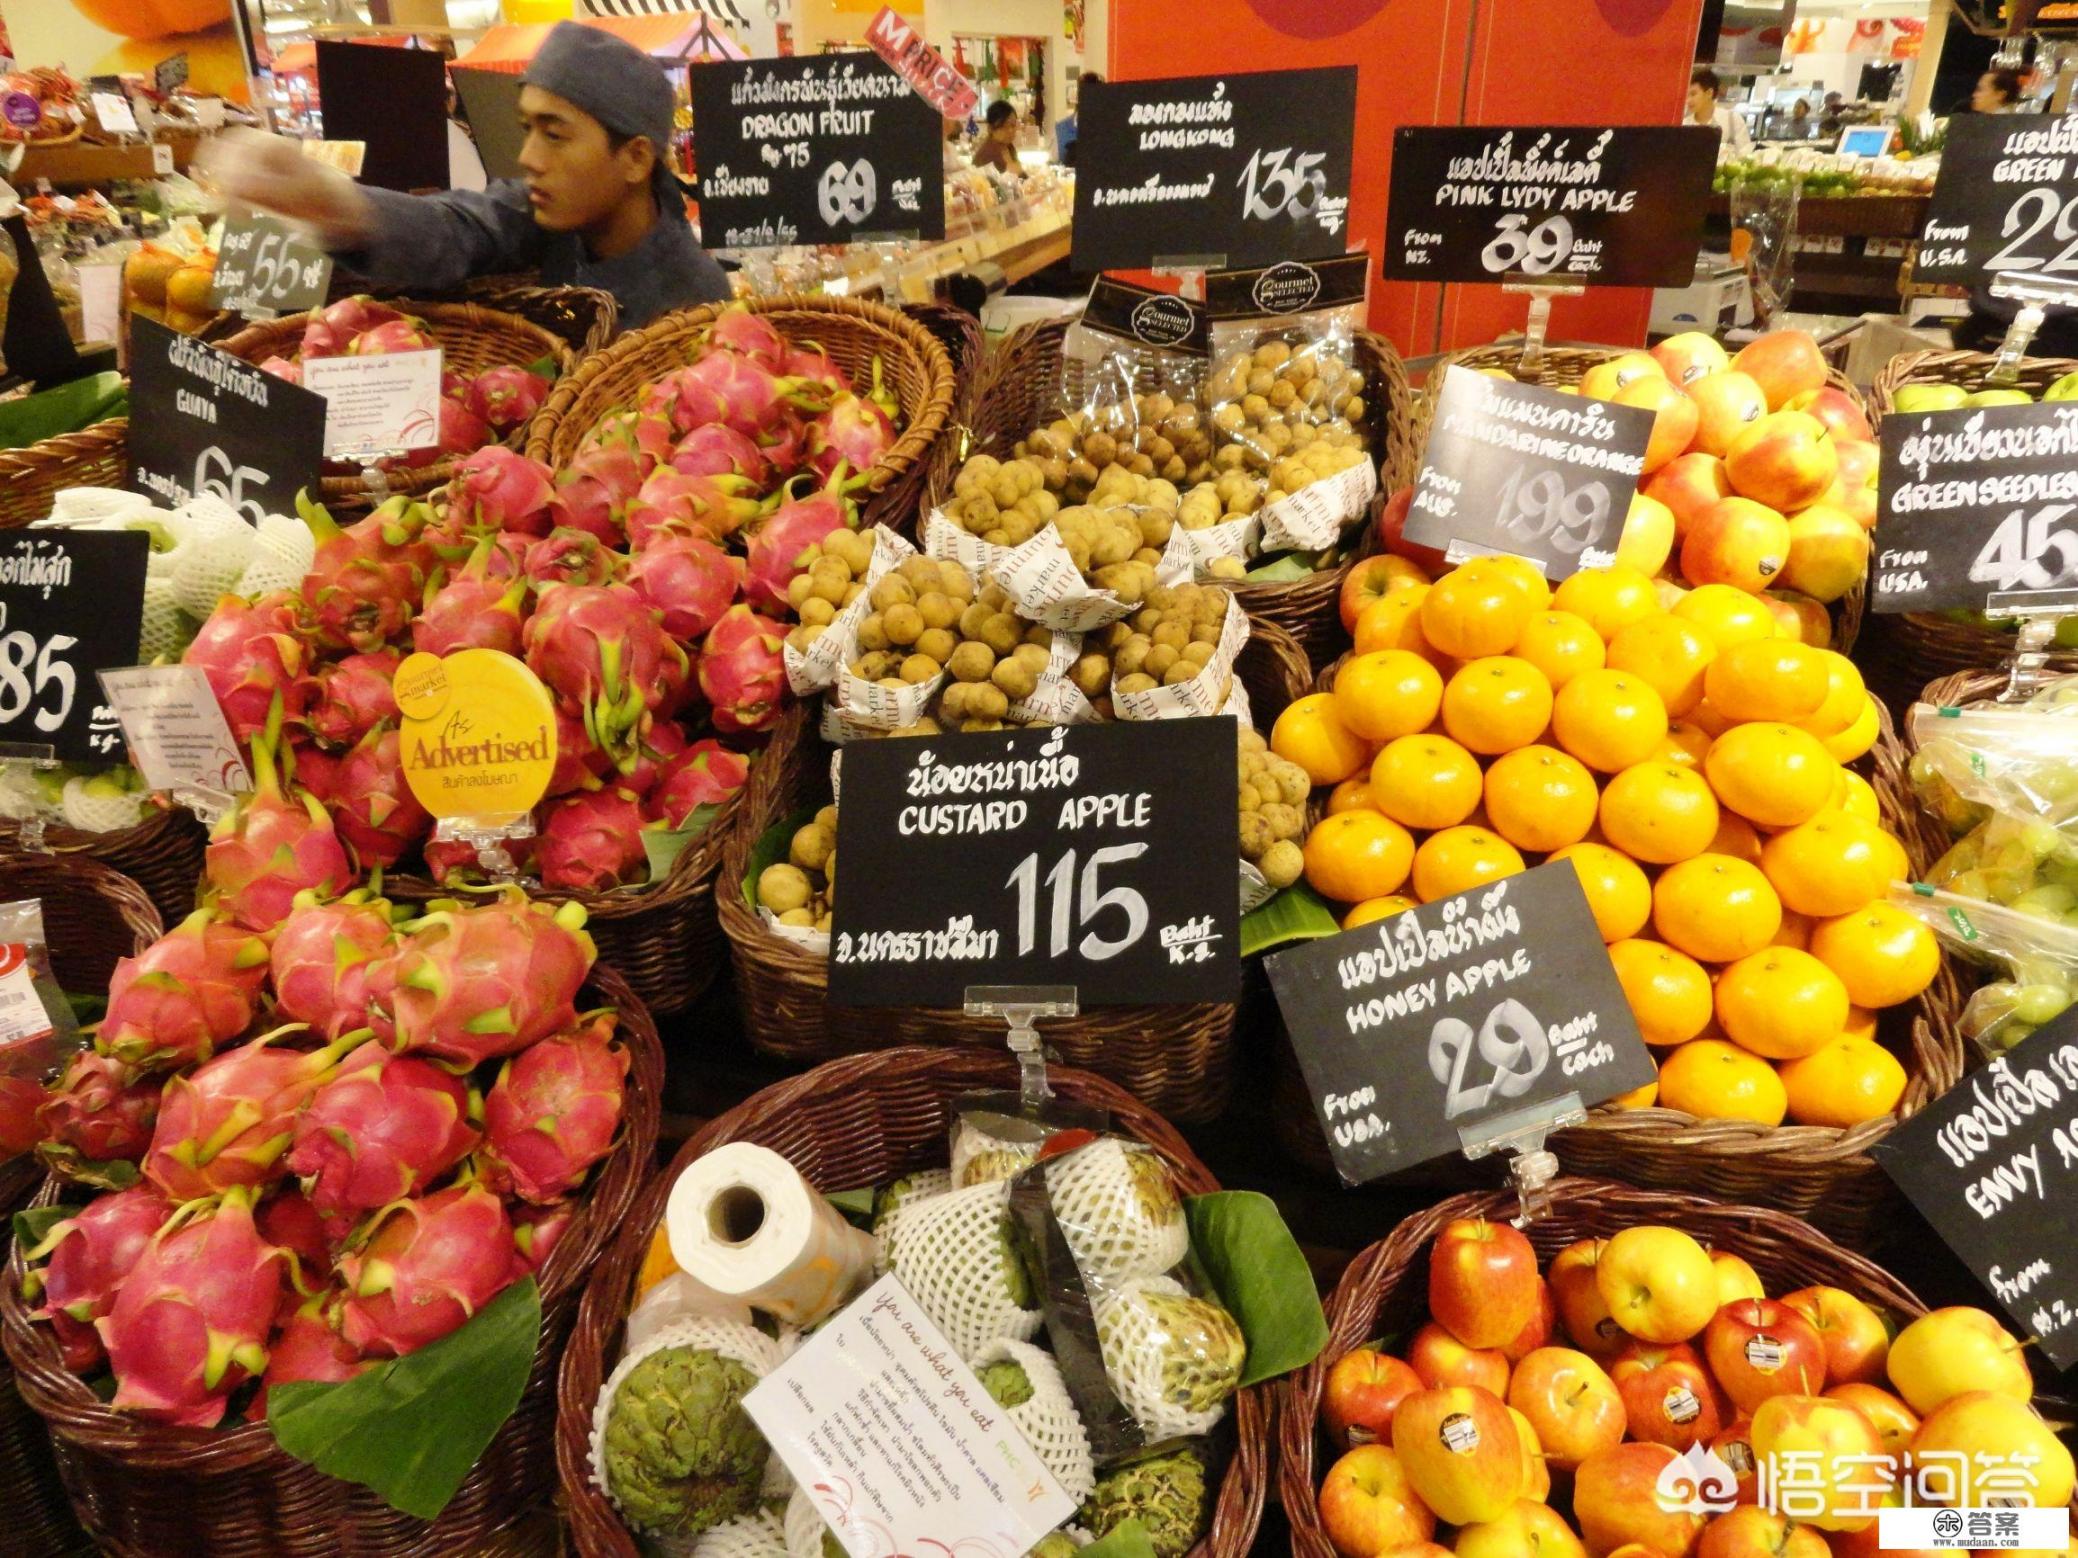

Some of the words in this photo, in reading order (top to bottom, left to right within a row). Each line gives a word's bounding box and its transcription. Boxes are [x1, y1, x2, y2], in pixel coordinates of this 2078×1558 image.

[742, 113, 814, 139] DRAGON
[820, 110, 875, 136] FRUIT
[1139, 128, 1235, 150] LONGKONG
[1236, 146, 1327, 221] 135
[1992, 157, 2066, 183] GREEN
[817, 158, 877, 226] 69
[1435, 183, 1493, 207] PINK
[1560, 188, 1637, 213] APPLE
[1404, 229, 1442, 246] From
[1481, 213, 1574, 276] 39
[1572, 238, 1602, 254] Baht
[1924, 218, 1970, 241] From
[1494, 464, 1611, 554] 199
[1891, 480, 1978, 513] GREEN
[1968, 504, 2078, 591] 45
[443, 710, 475, 740] As
[409, 725, 549, 771] Advertised
[906, 726, 1080, 797] น้อยหน่าเนื้อ
[898, 800, 1027, 836] CUSTARD
[1058, 793, 1152, 831] APPLE
[1004, 841, 1150, 961] 115
[1160, 915, 1215, 946] Baht
[1346, 978, 1437, 1034] HONEY
[1446, 948, 1531, 1001] APPLE
[1548, 1011, 1599, 1047] Baht
[1428, 998, 1549, 1120] 29
[1323, 1085, 1376, 1120] From
[1965, 1143, 2045, 1220] ENVY
[900, 1322, 920, 1346] are
[919, 1344, 954, 1382] what
[943, 1380, 970, 1407] you
[969, 1410, 994, 1432] eat
